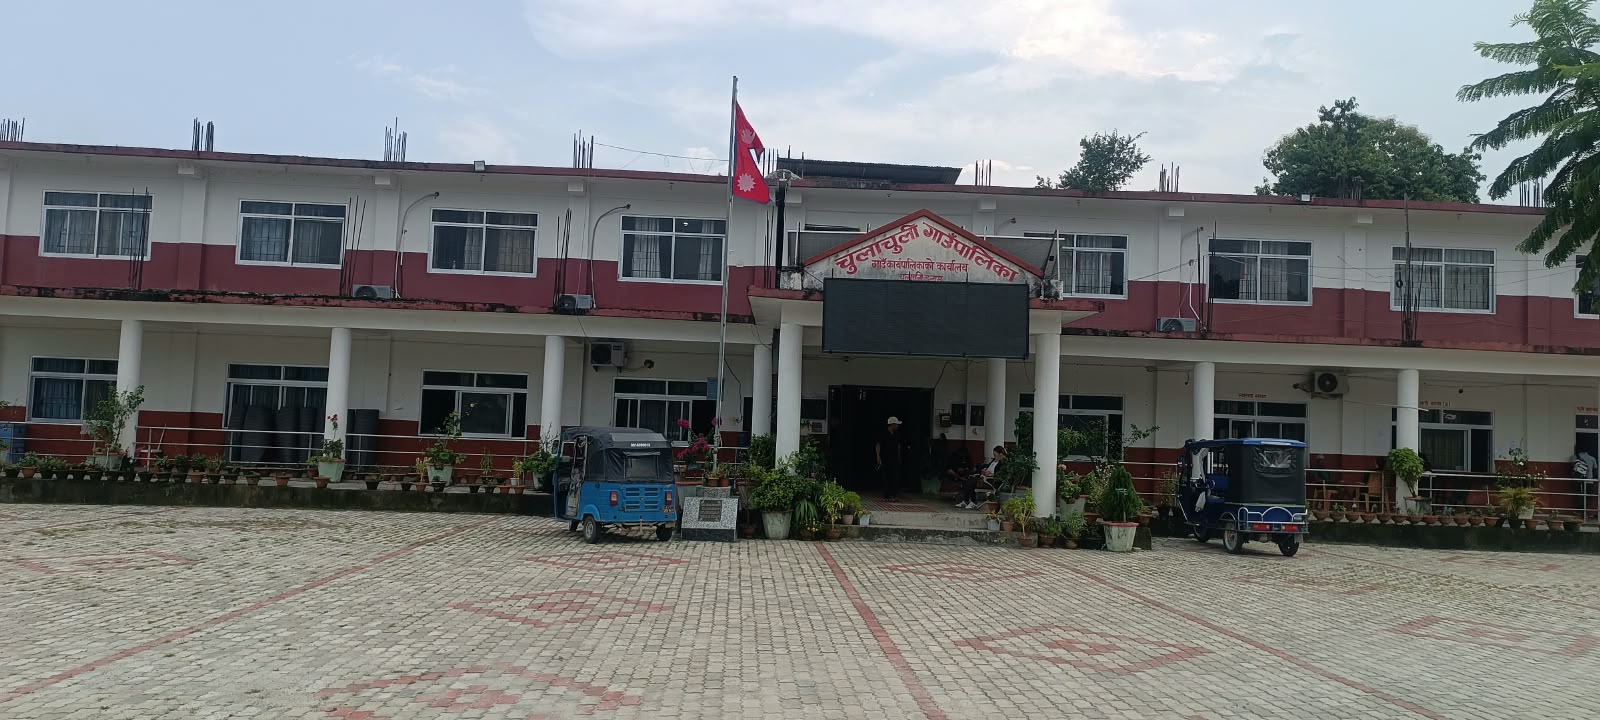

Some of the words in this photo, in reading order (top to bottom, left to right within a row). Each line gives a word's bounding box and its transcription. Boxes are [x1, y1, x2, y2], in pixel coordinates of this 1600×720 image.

[835, 224, 920, 274] चुलाचुली
[922, 221, 1019, 282] गाउँपालिका
[936, 260, 969, 273] कार्यालय
